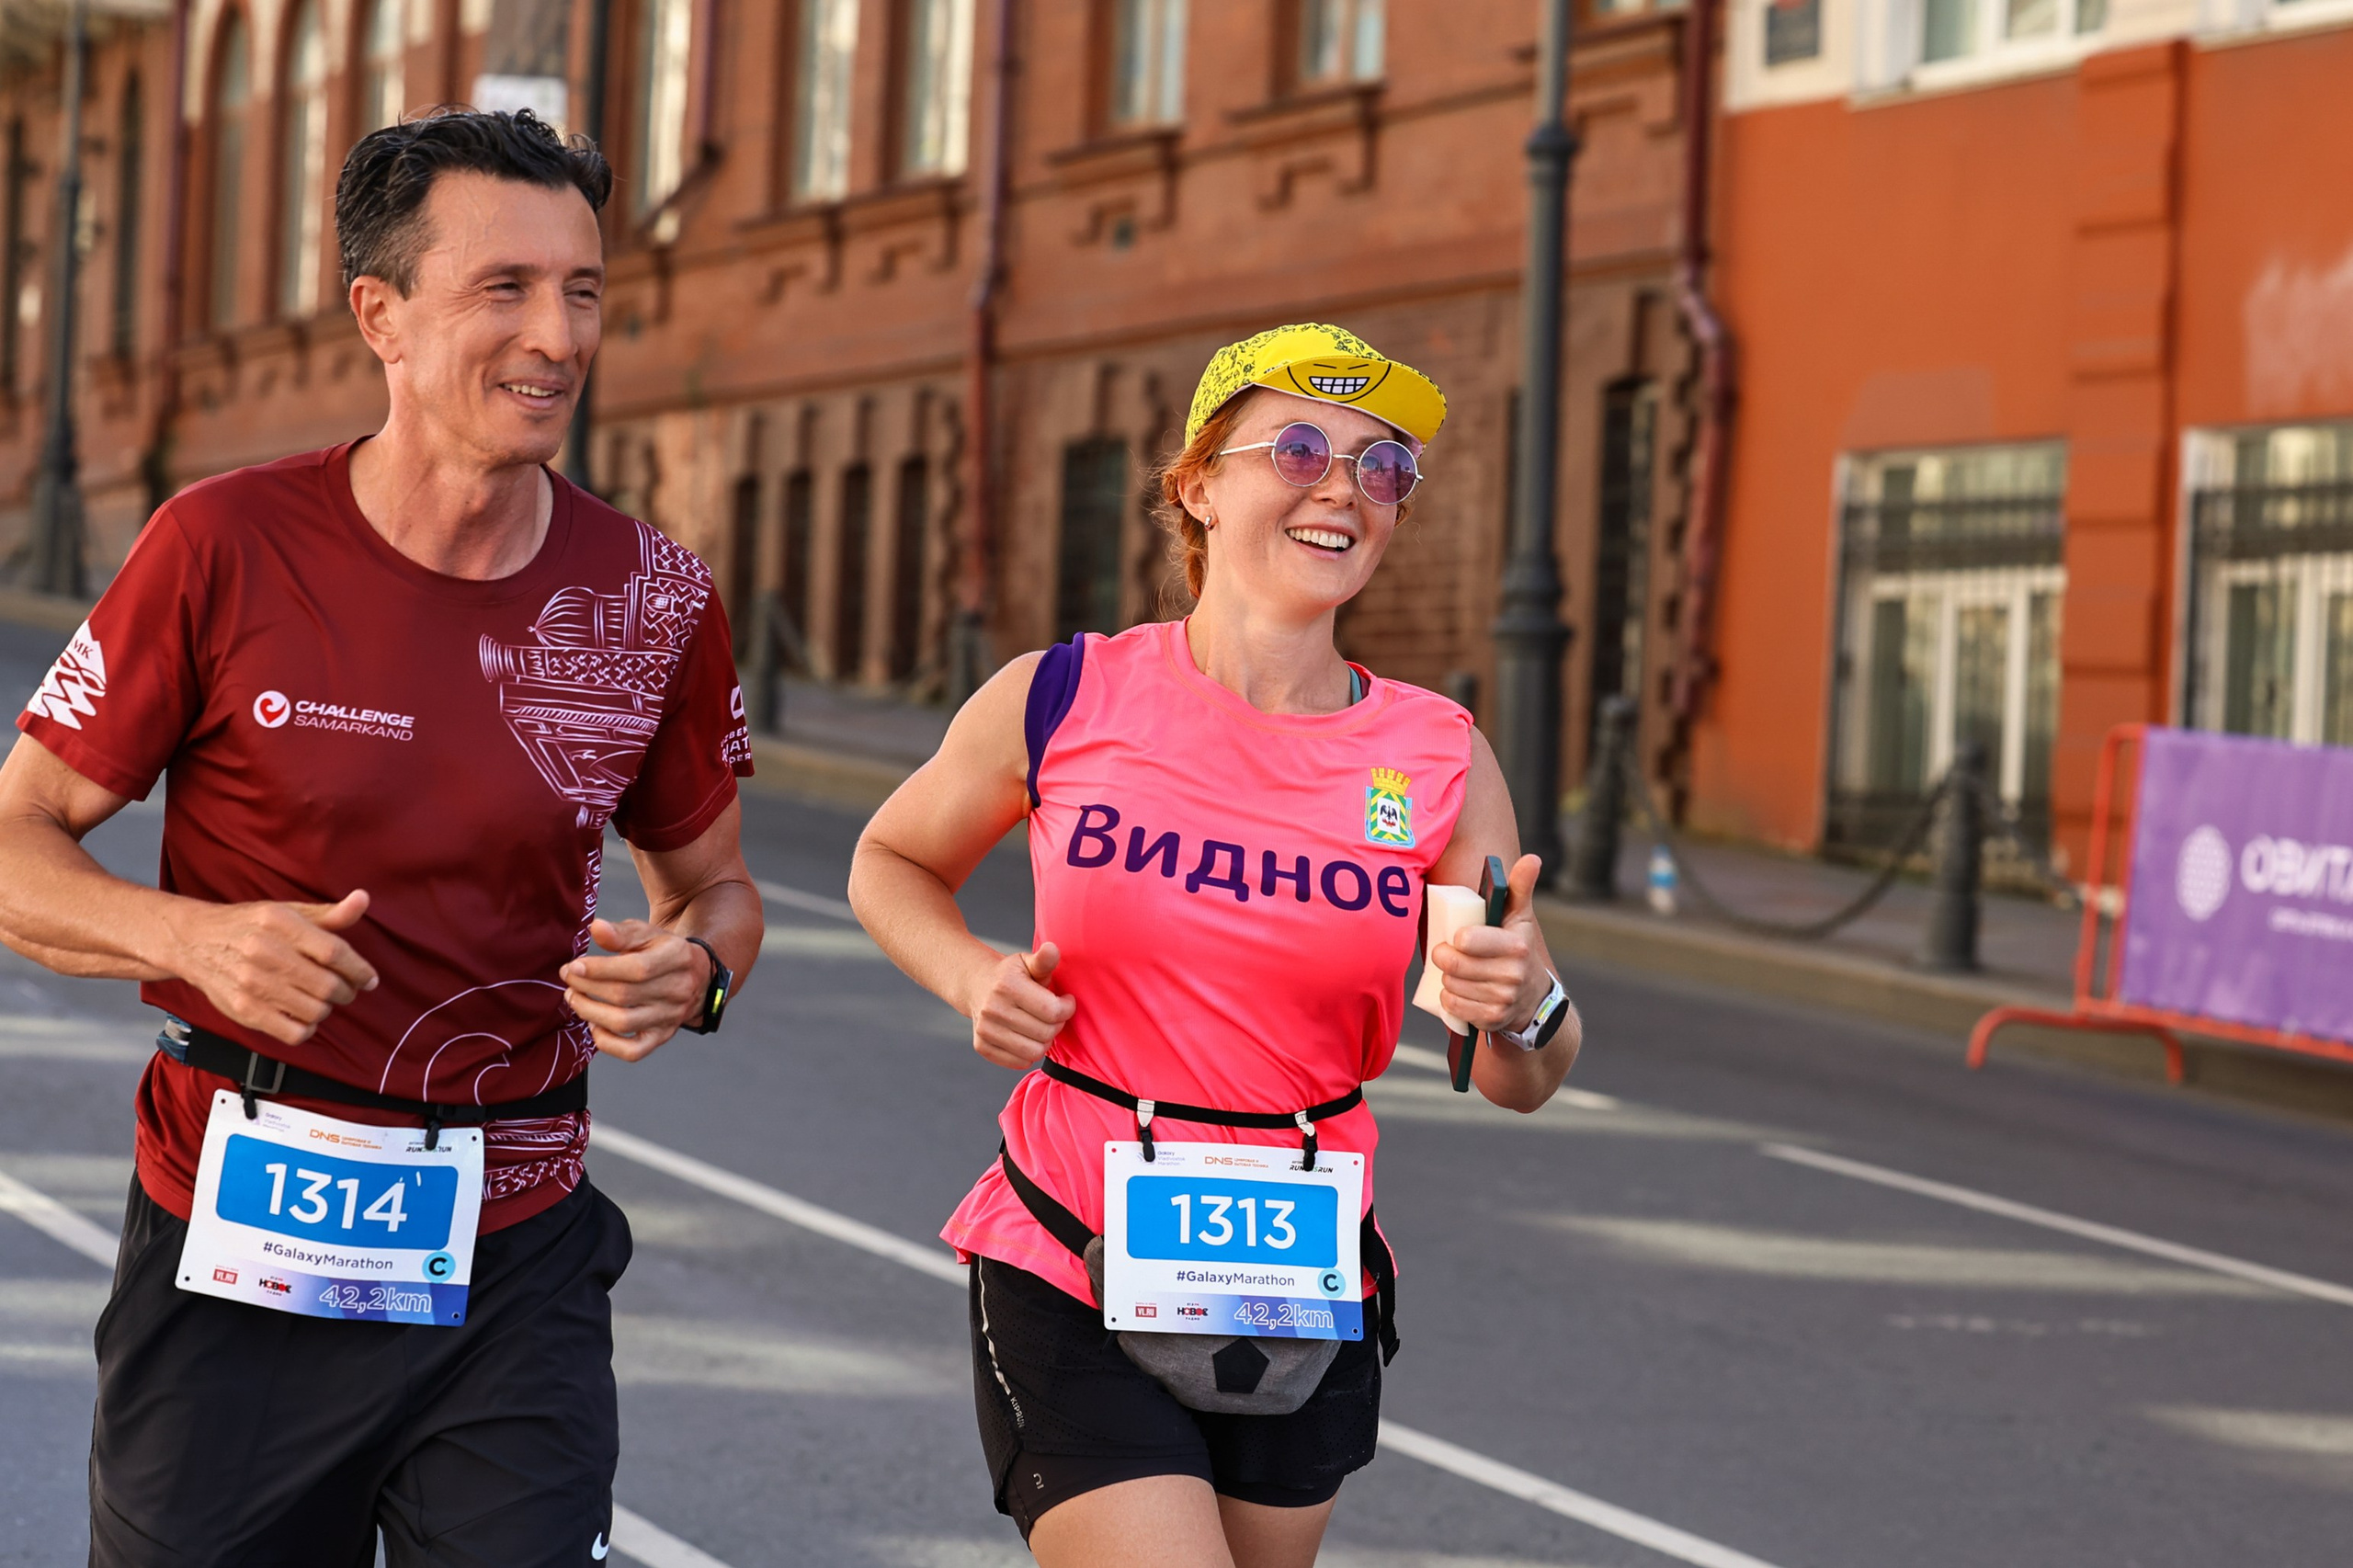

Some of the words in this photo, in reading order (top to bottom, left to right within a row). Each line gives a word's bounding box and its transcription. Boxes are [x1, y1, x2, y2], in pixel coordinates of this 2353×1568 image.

[293, 714, 414, 742] SAMARKAND
[295, 700, 415, 728] CHALLENGE
[1066, 803, 1411, 918] Видное
[309, 1129, 341, 1144] DNS
[1204, 1155, 1233, 1166] DNS
[266, 1163, 408, 1233] 1314
[1170, 1193, 1297, 1250] 1313
[263, 1241, 393, 1270] #GalaxyMarathon
[1176, 1270, 1295, 1287] #GalaxyMarathon
[318, 1284, 432, 1314] 42,2km
[1136, 1307, 1155, 1317] VL.RU
[1233, 1301, 1333, 1330] 42,2km
[1010, 1396, 1025, 1428] KIPRUN
